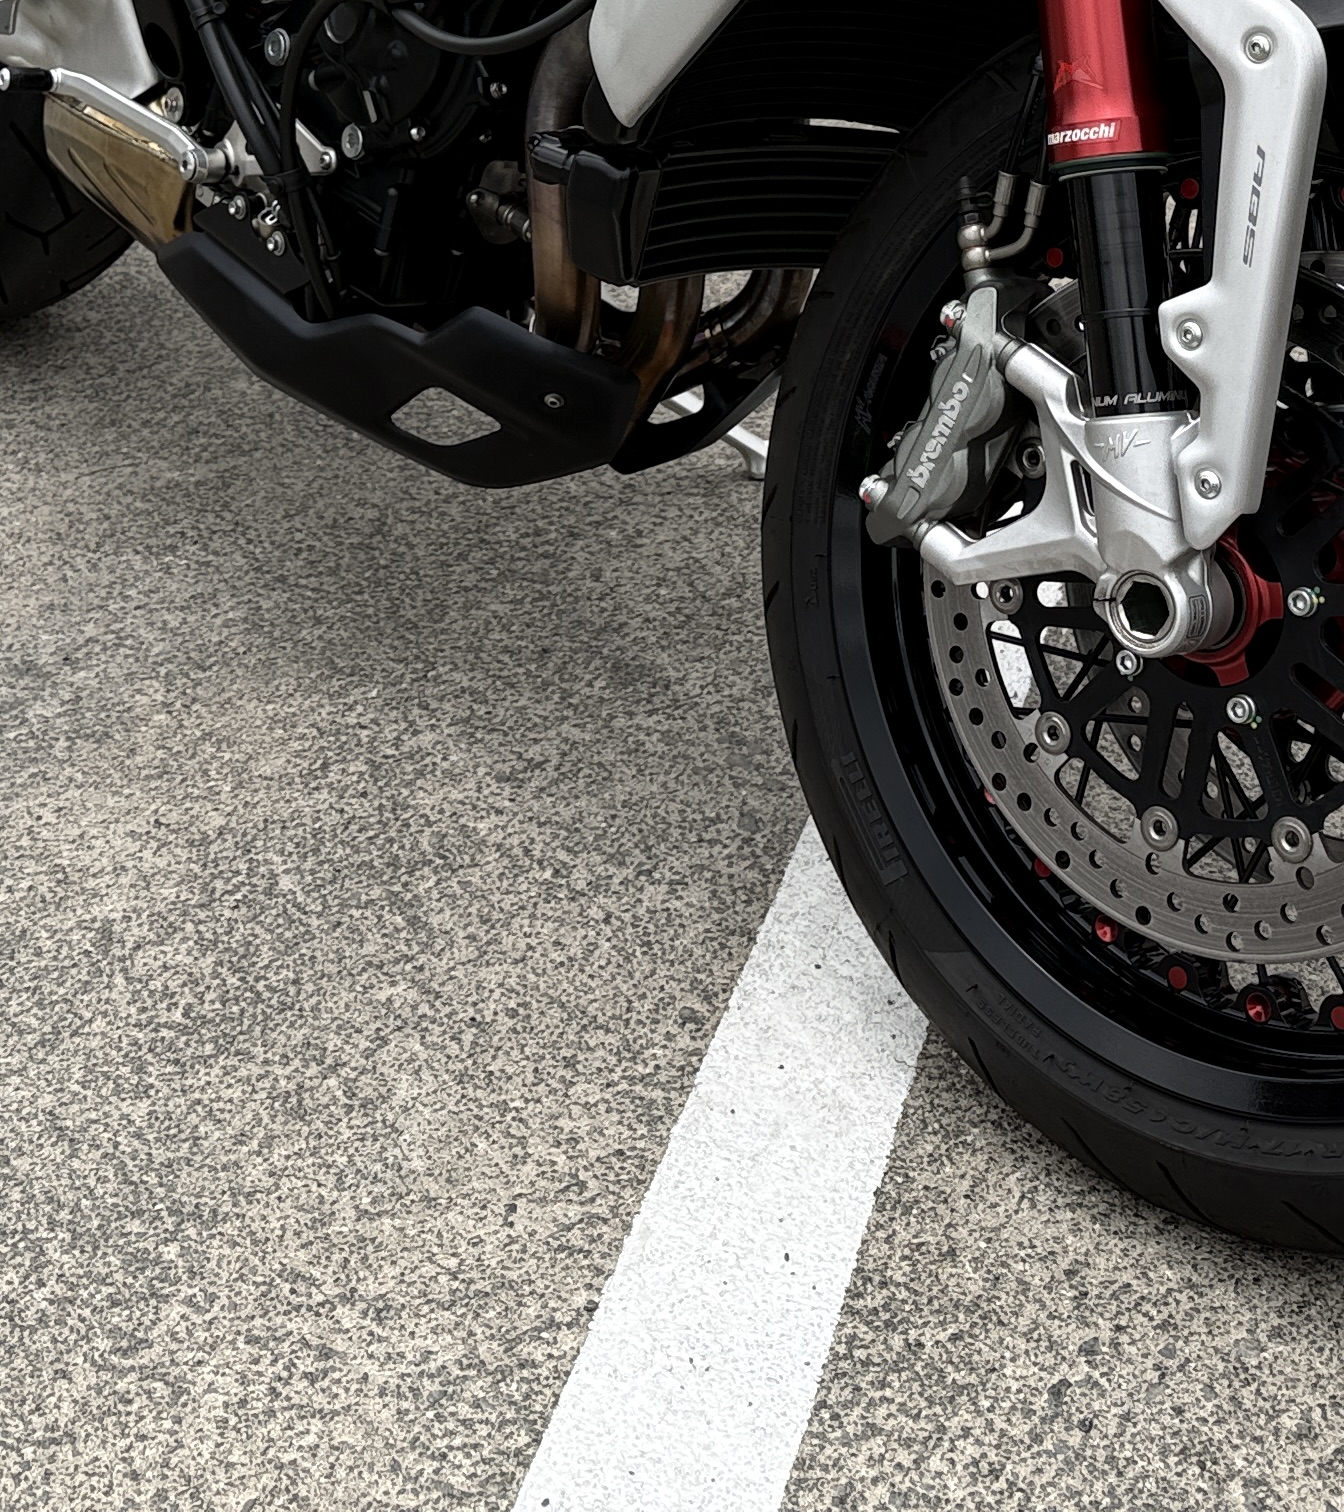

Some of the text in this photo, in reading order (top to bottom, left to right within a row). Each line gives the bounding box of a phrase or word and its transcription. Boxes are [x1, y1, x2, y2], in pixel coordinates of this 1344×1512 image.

[1047, 122, 1116, 146] marzocchi
[1242, 144, 1266, 268] ABS
[907, 380, 969, 489] brembo
[832, 751, 909, 887] PIRELLI
